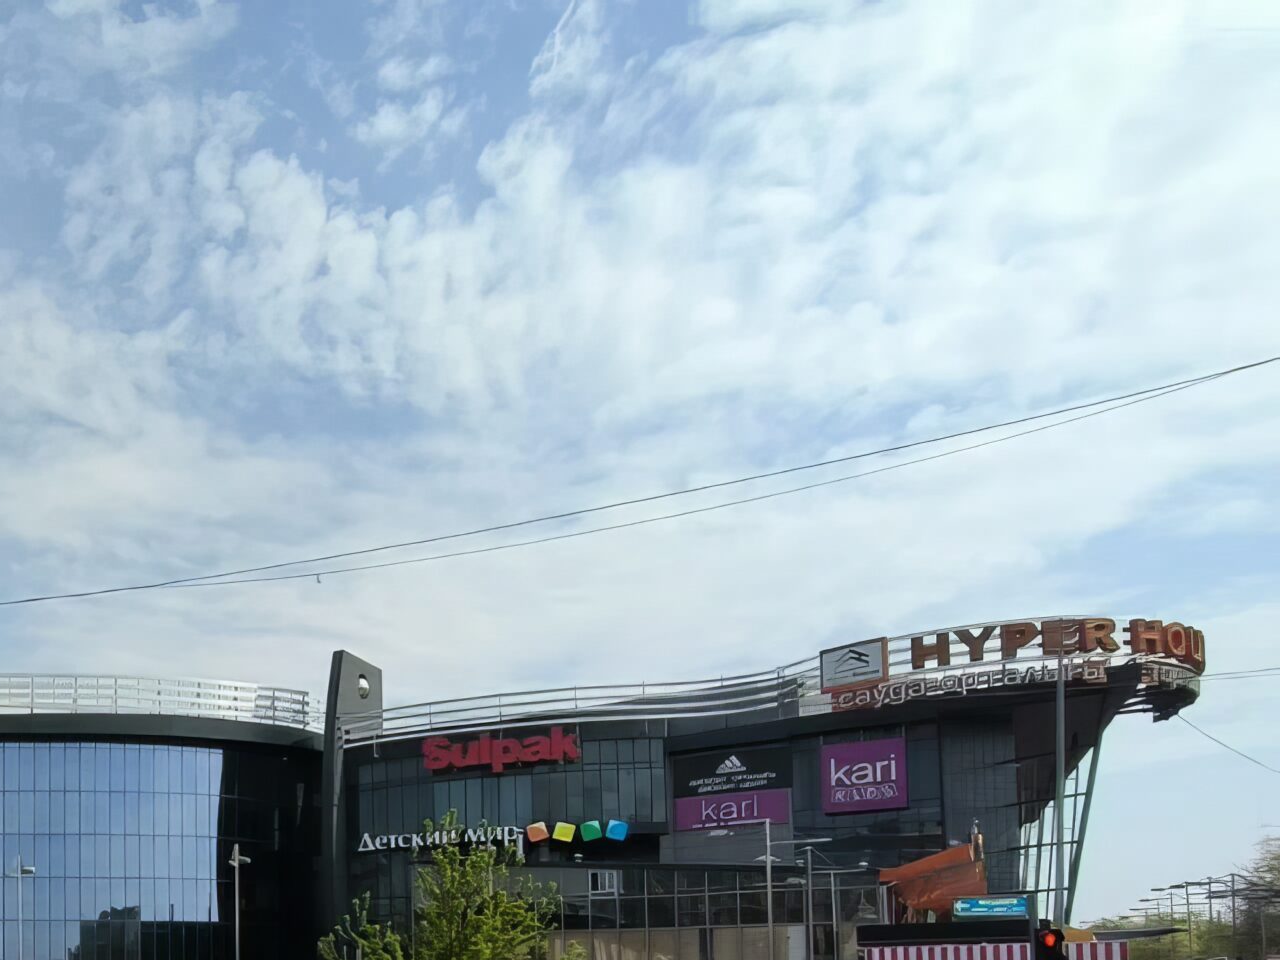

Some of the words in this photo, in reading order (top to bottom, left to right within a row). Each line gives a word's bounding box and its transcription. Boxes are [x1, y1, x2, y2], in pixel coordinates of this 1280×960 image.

[910, 617, 1120, 671] HYPER
[422, 725, 581, 774] Sulpak
[830, 753, 897, 787] kari
[701, 794, 758, 821] kari
